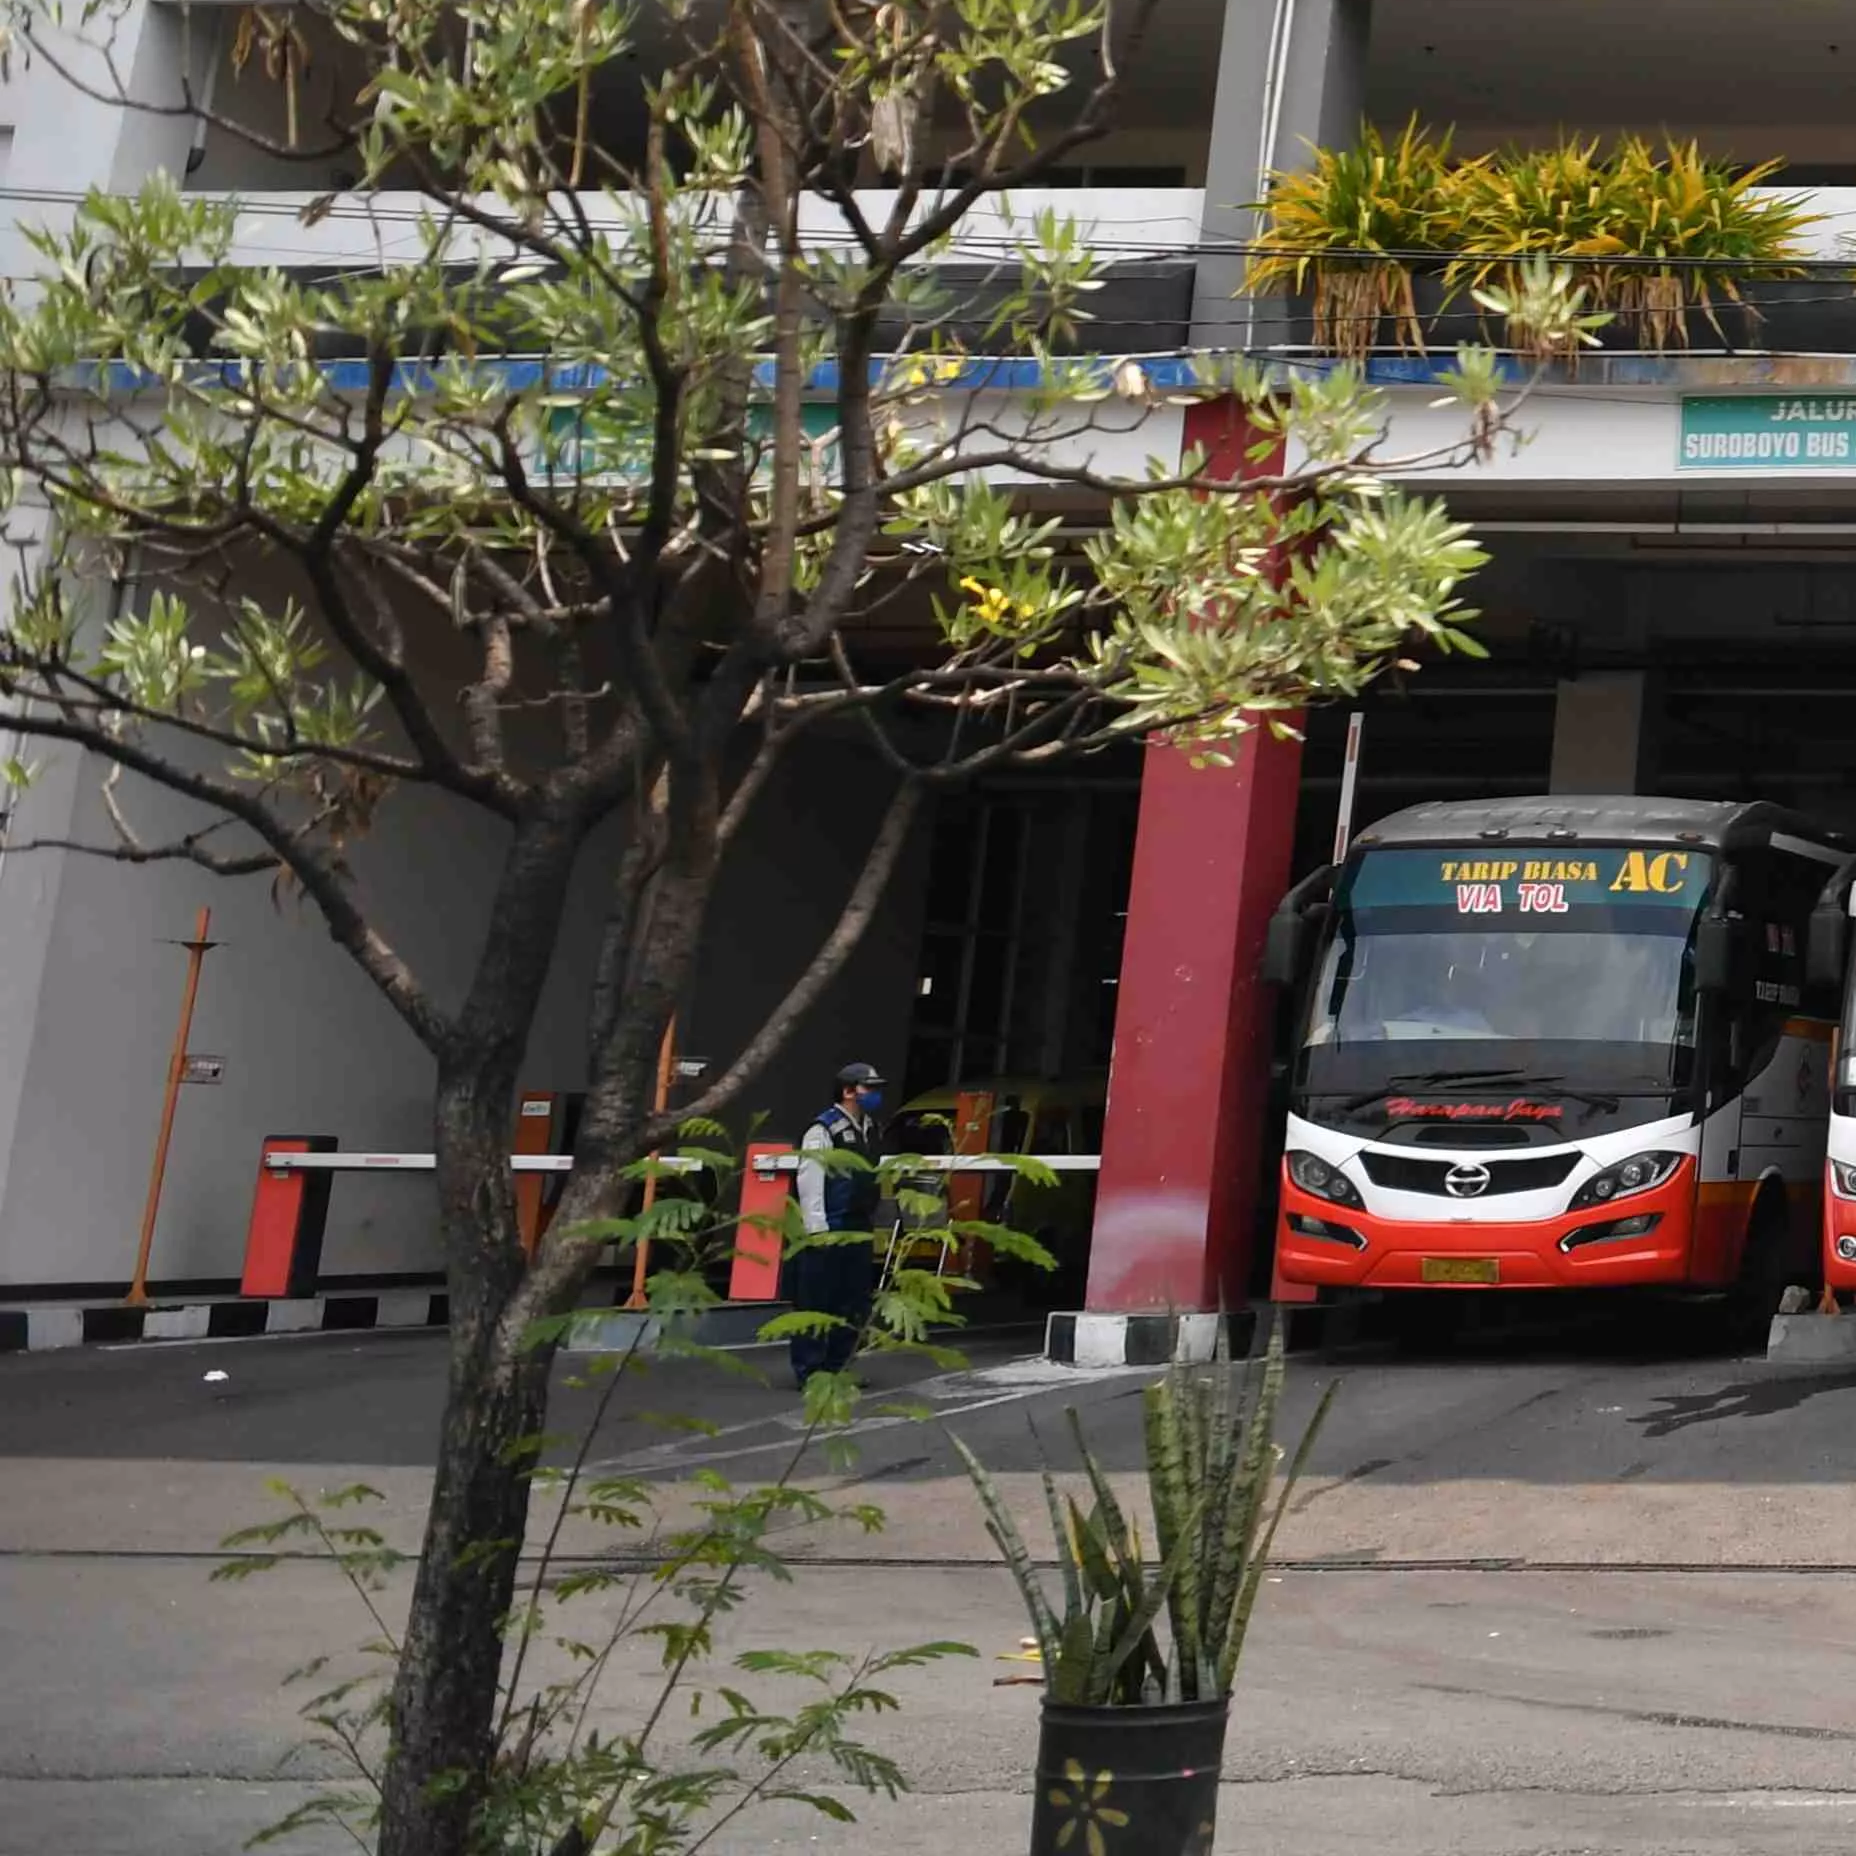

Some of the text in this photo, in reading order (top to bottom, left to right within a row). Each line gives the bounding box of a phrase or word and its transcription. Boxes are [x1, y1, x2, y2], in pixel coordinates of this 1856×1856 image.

[1685, 432, 1799, 459] SUROBOYO
[1806, 432, 1849, 458] BUS
[1441, 862, 1598, 882] TARIP BIASA
[1608, 851, 1689, 894] AC
[1456, 884, 1569, 913] VIA TOL
[1384, 1097, 1564, 1121] Harapan Jaya
